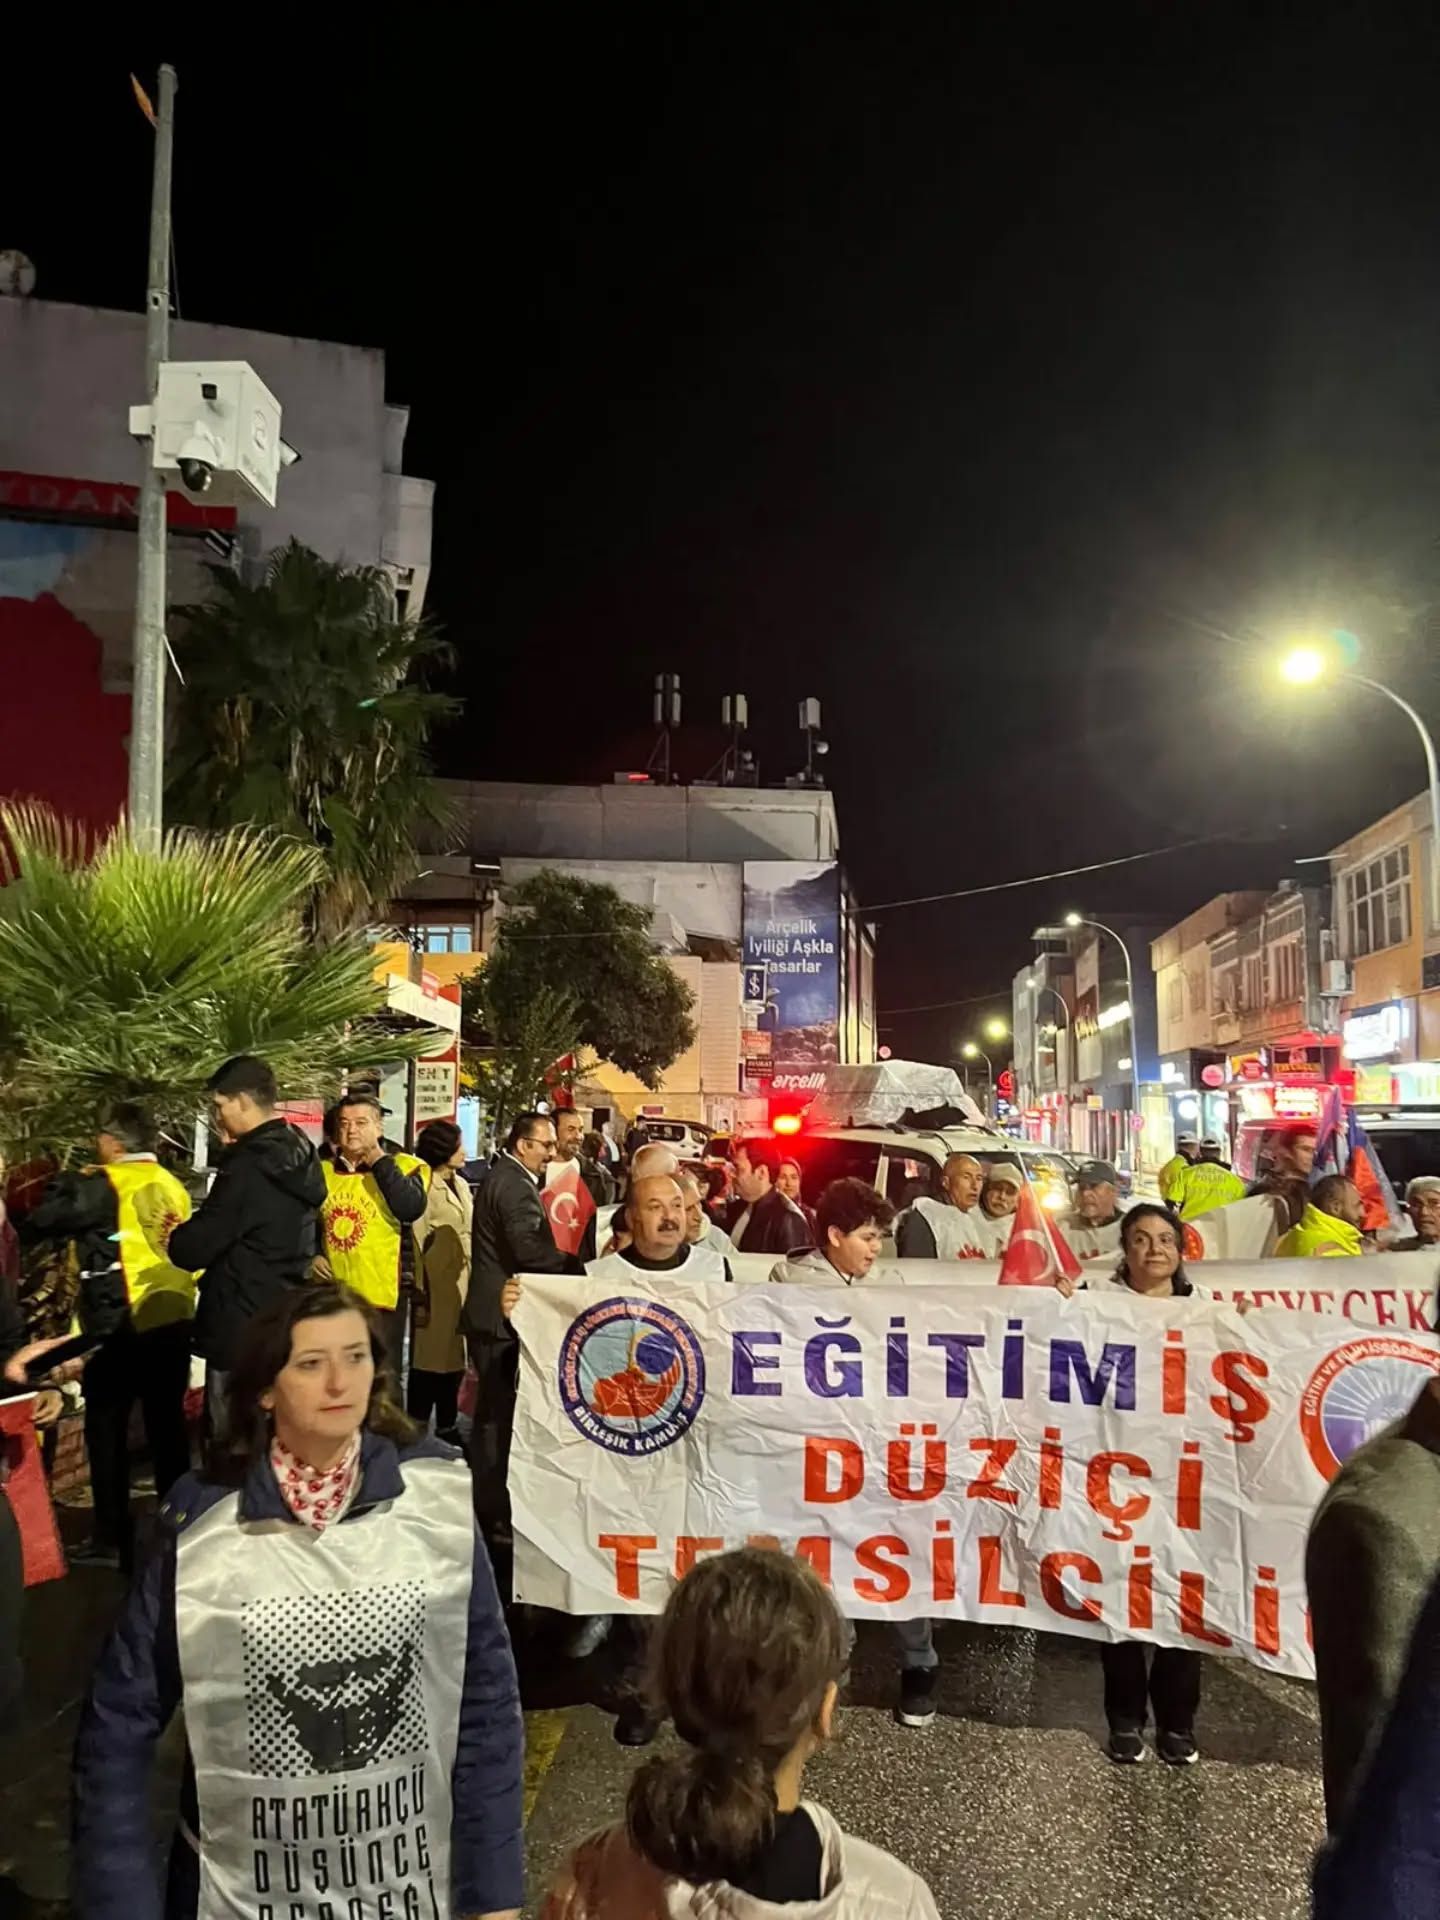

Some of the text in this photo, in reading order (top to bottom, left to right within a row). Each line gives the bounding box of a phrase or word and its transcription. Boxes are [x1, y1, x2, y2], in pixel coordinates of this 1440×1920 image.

[749, 936, 834, 957] İyiliği Aşkla
[766, 919, 817, 938] Arçelik
[572, 1405, 630, 1450] BİRLEŞİK
[804, 1423, 1204, 1542] DÜZİÇİ
[252, 1762, 425, 1841] ATATÜRKÇÜ
[254, 1824, 430, 1894] DÜŞÜNCE
